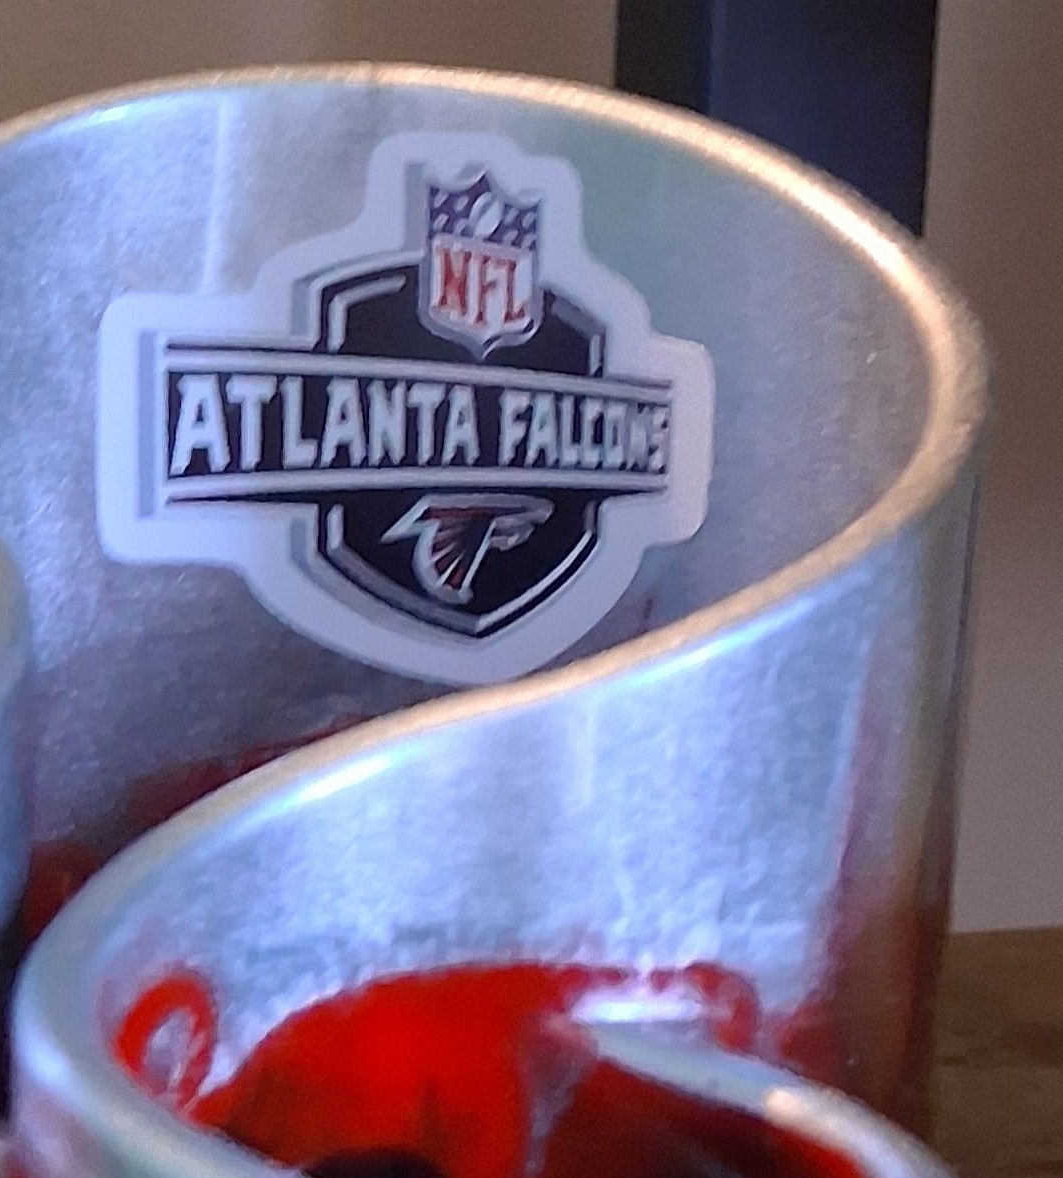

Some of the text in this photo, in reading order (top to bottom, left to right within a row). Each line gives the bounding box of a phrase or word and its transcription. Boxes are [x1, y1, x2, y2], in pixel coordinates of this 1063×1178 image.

[437, 247, 526, 326] NFL
[170, 374, 669, 475] ATLANTA FALCONS
